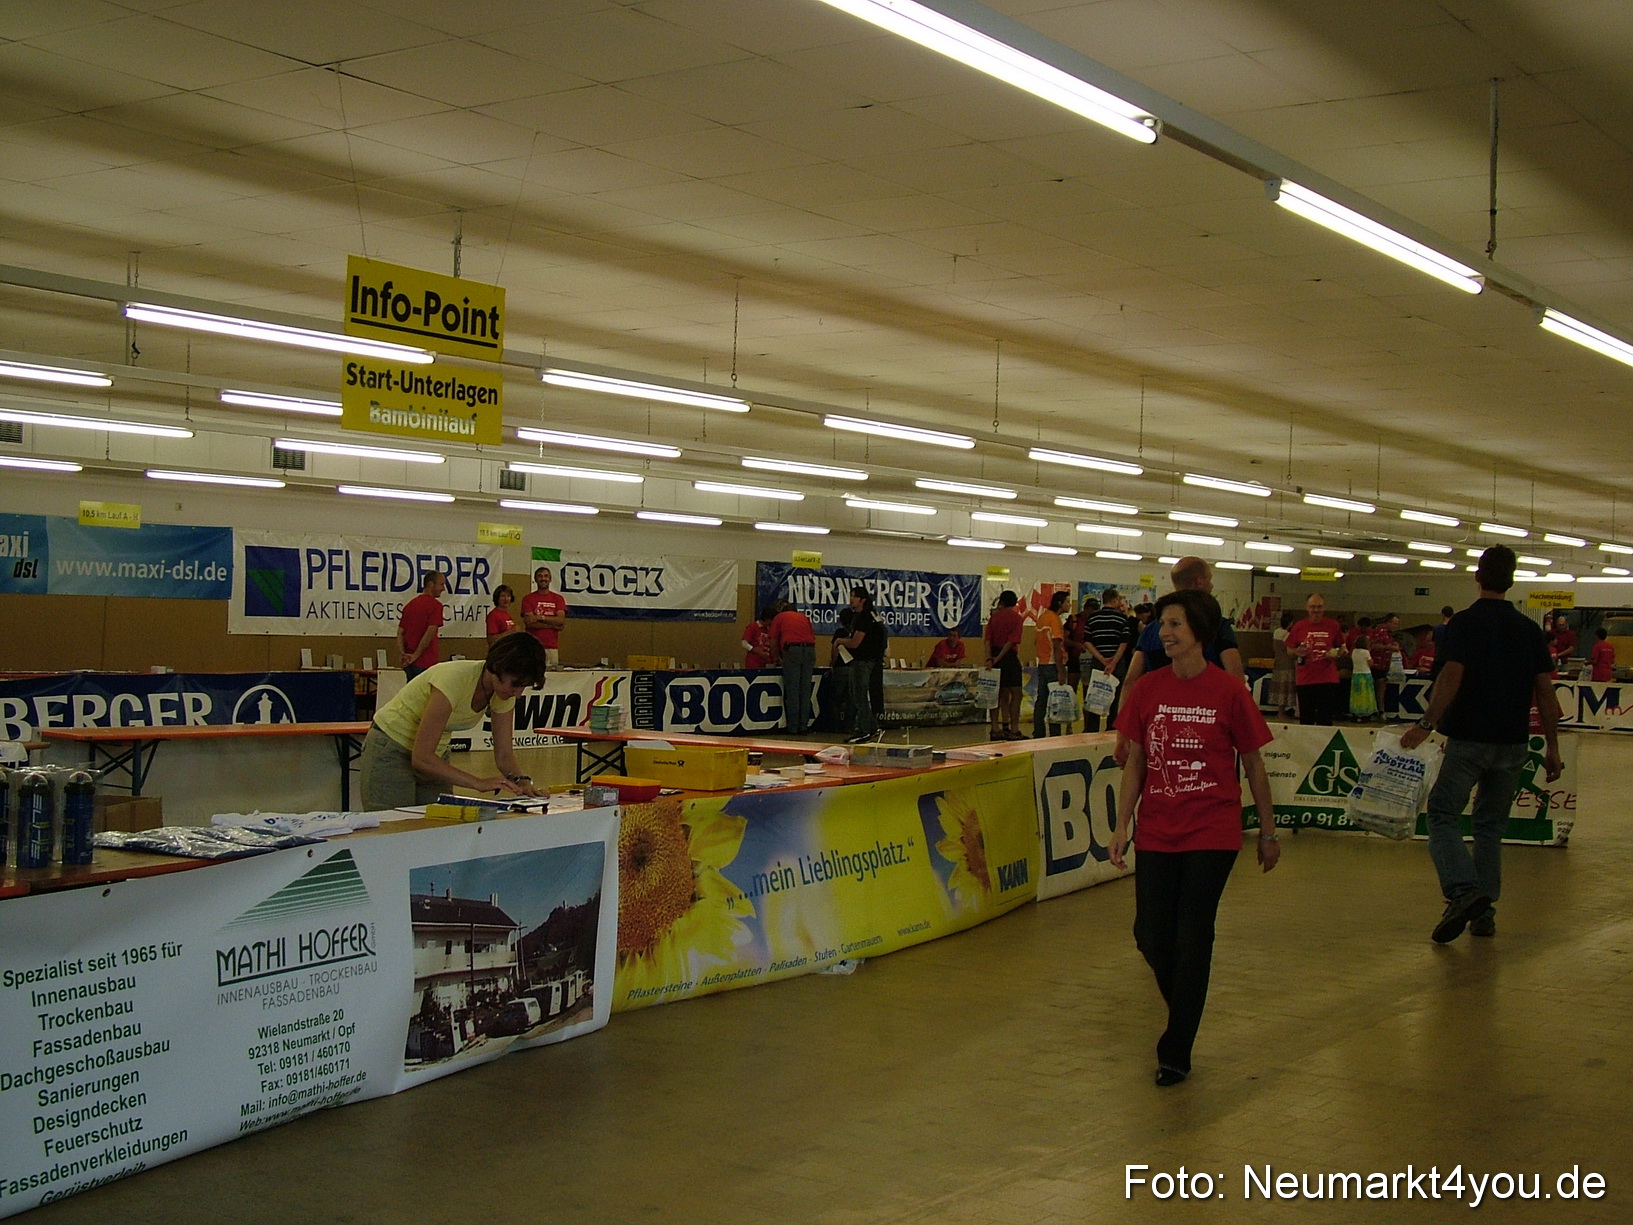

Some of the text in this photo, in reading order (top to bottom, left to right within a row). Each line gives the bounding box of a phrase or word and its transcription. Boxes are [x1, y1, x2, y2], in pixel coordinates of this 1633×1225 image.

[351, 275, 499, 340] Info-Point
[346, 362, 498, 407] Start-Unterlagen
[369, 400, 477, 436] Bambinilauf
[82, 509, 96, 519] 10,5
[0, 531, 29, 558] axi
[13, 558, 38, 579] dsl
[55, 559, 227, 582] www.maxi-dsl.de
[306, 548, 491, 595] PFLEIDERER
[561, 562, 664, 597] BOCK
[306, 601, 491, 622] AKTIENGESCHAFT
[1158, 704, 1217, 717] Neumarkter
[1172, 714, 1217, 725] STADTLAUF
[1302, 812, 1312, 824] 0
[1317, 812, 1334, 827] 91
[997, 858, 1029, 892] KANN
[3, 941, 182, 989] Spezialist seit 1965 für
[216, 937, 286, 980] MATHI
[299, 923, 376, 963] HOFFER
[626, 935, 883, 1001] Pflastersteine Außenplatten Palisaden Stufen Gartenmauern
[31, 976, 136, 1007] Innenausbau
[217, 961, 378, 1006] INNENAUSBAU TROCKENBAU
[262, 983, 340, 1010] FASSADENBAU
[38, 1000, 133, 1031] Trockenbau
[258, 1008, 344, 1040] Wielandstraße 20
[32, 1023, 142, 1058] Fassadenbau
[248, 1041, 279, 1060] 92318
[282, 1030, 331, 1051] Neumarkt
[338, 1023, 356, 1038] Opf
[257, 1062, 277, 1075] Tel:
[279, 1052, 309, 1070] 09181
[317, 1041, 350, 1060] 460170
[0, 1039, 170, 1091] Dachgeschoßausbau
[261, 1058, 350, 1093] Fax: 09181/460171
[38, 1070, 139, 1107] Sanierungen
[240, 1070, 367, 1117] Mail: info@mathi-hoffer.de
[33, 1092, 147, 1134] Designdecken
[44, 1117, 143, 1157] Feuerschutz
[0, 1129, 188, 1198] Fassadenverkleidungen
